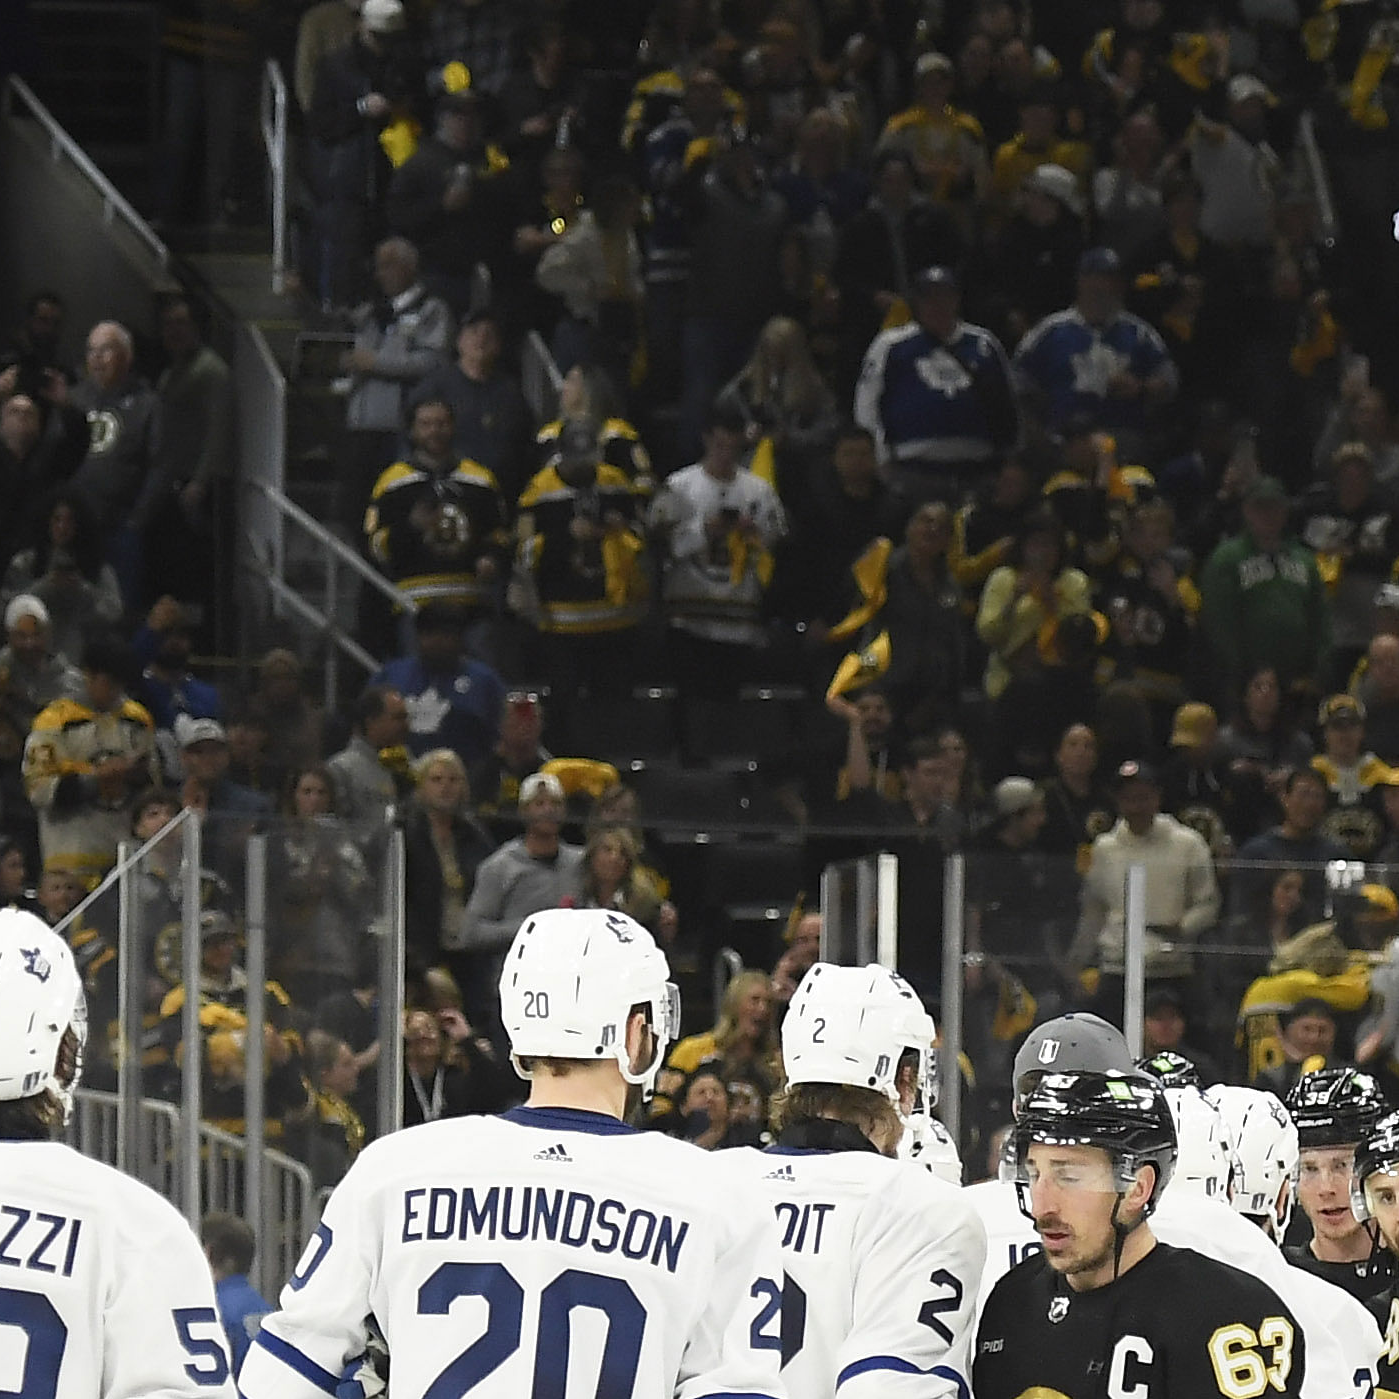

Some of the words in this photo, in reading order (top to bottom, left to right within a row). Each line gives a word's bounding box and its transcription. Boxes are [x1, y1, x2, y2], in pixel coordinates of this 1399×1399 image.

[523, 990, 550, 1019] 20
[813, 1018, 828, 1044] 2
[402, 1186, 689, 1273] EDMUNDSON
[750, 1276, 783, 1350] 2
[917, 1268, 964, 1348] 2
[172, 1307, 231, 1387] 5
